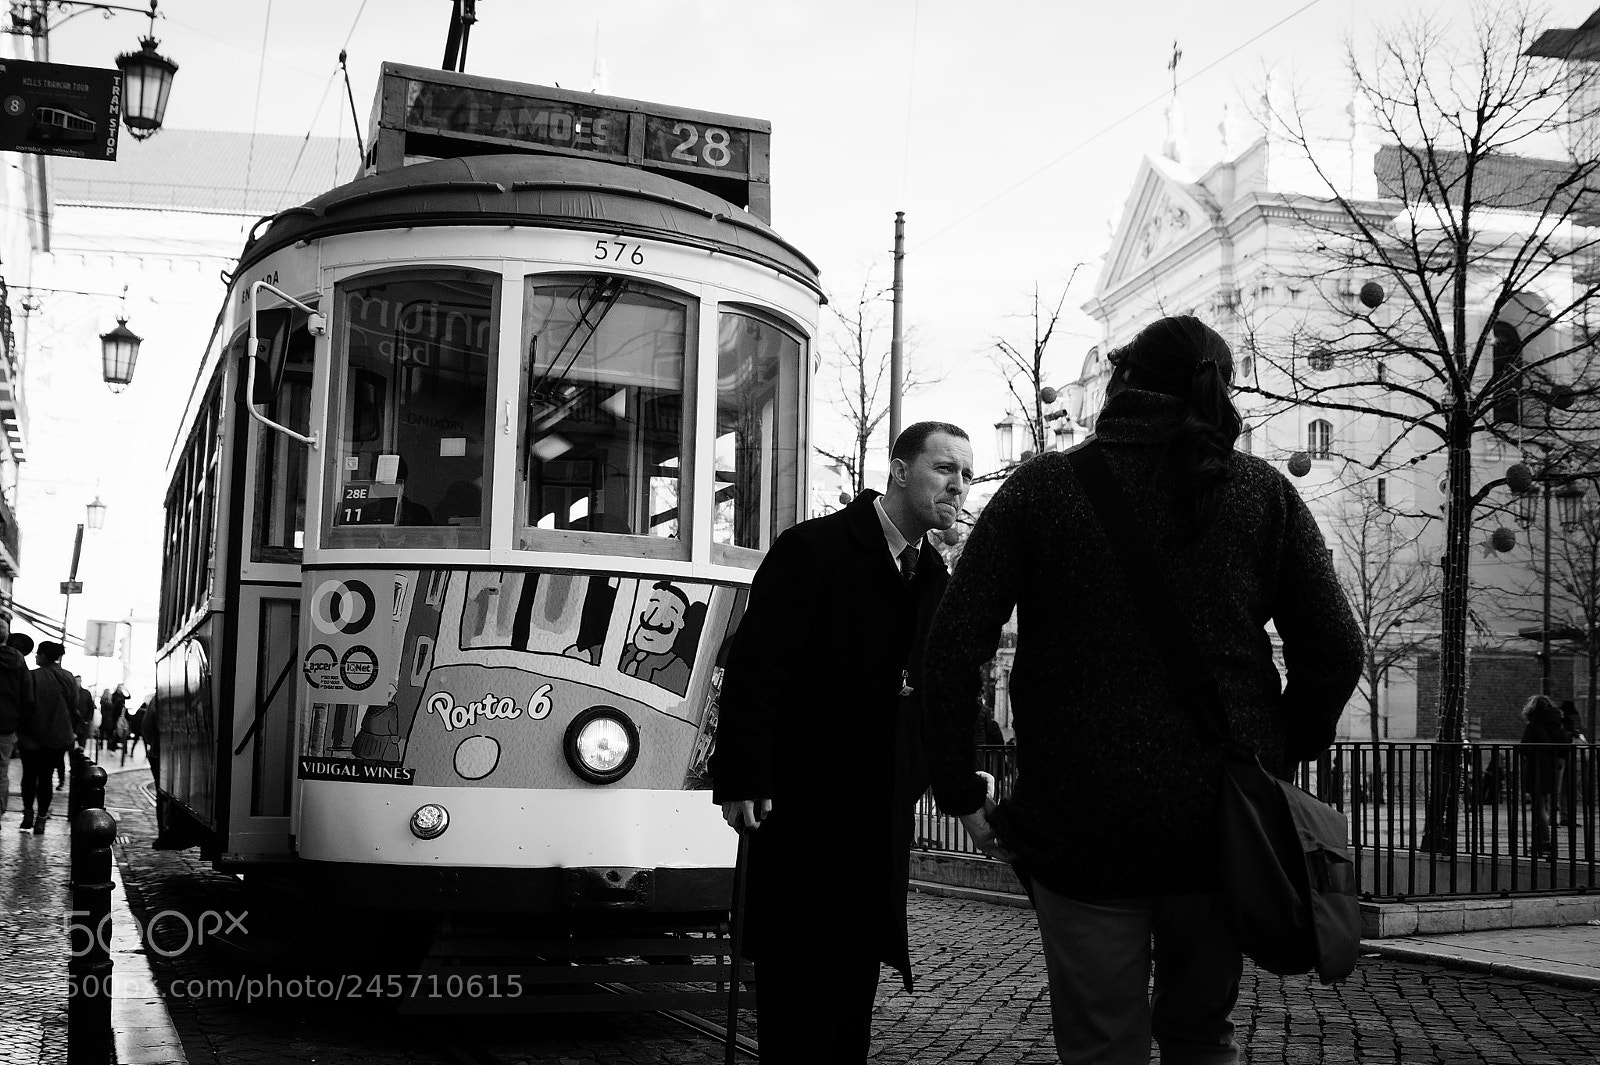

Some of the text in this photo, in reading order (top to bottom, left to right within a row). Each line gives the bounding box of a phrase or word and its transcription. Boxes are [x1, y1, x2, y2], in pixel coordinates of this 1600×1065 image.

[10, 99, 20, 112] 8
[106, 76, 121, 156] TRAM STOP
[671, 122, 731, 167] 28
[594, 240, 644, 265] 576
[346, 488, 368, 499] 28E
[344, 508, 362, 522] 11
[346, 663, 372, 674] IQNet
[426, 684, 553, 732] Porta 6
[302, 761, 412, 780] VIDIGAL WINES
